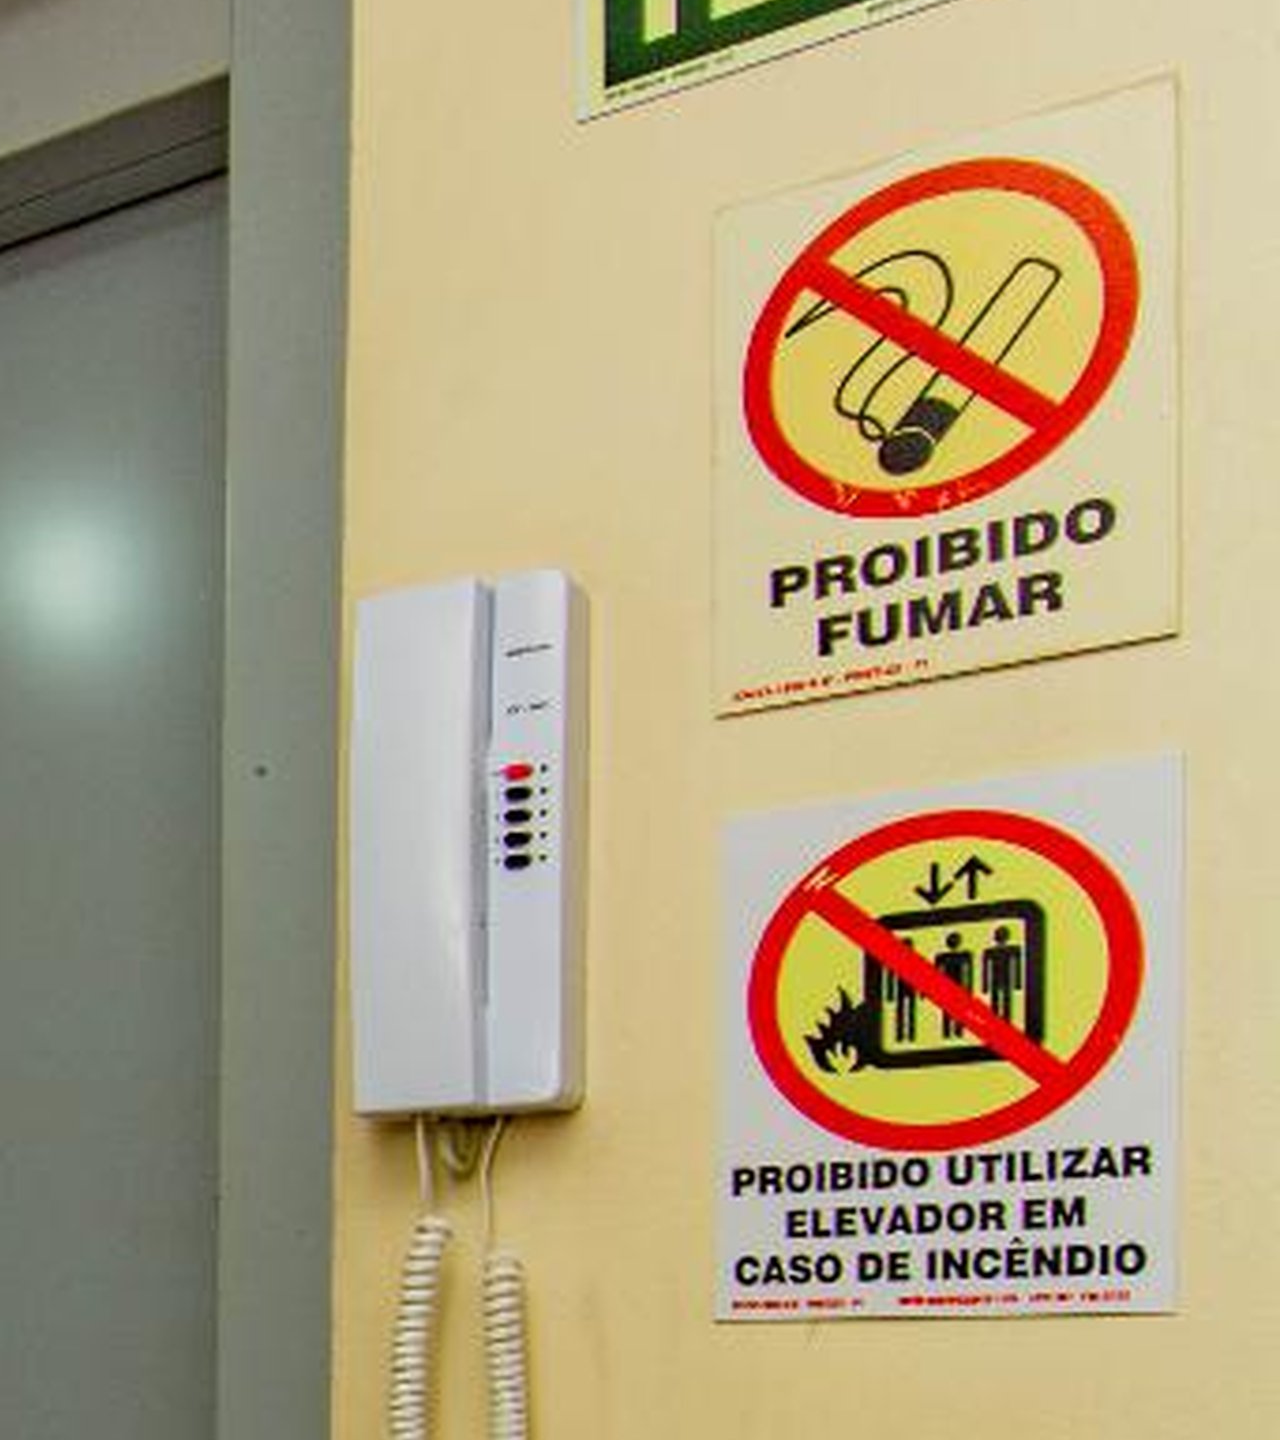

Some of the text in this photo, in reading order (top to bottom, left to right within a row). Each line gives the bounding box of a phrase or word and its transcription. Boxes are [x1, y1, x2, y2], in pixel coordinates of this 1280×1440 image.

[769, 496, 1117, 609] PROIBIDO
[816, 571, 1063, 657] FUMAR
[732, 1145, 1152, 1196] PROIBIDO UTILIZAR
[785, 1198, 1086, 1239] ELEVADOR EM
[734, 1236, 1147, 1287] CASO DE INCÊNDIO
